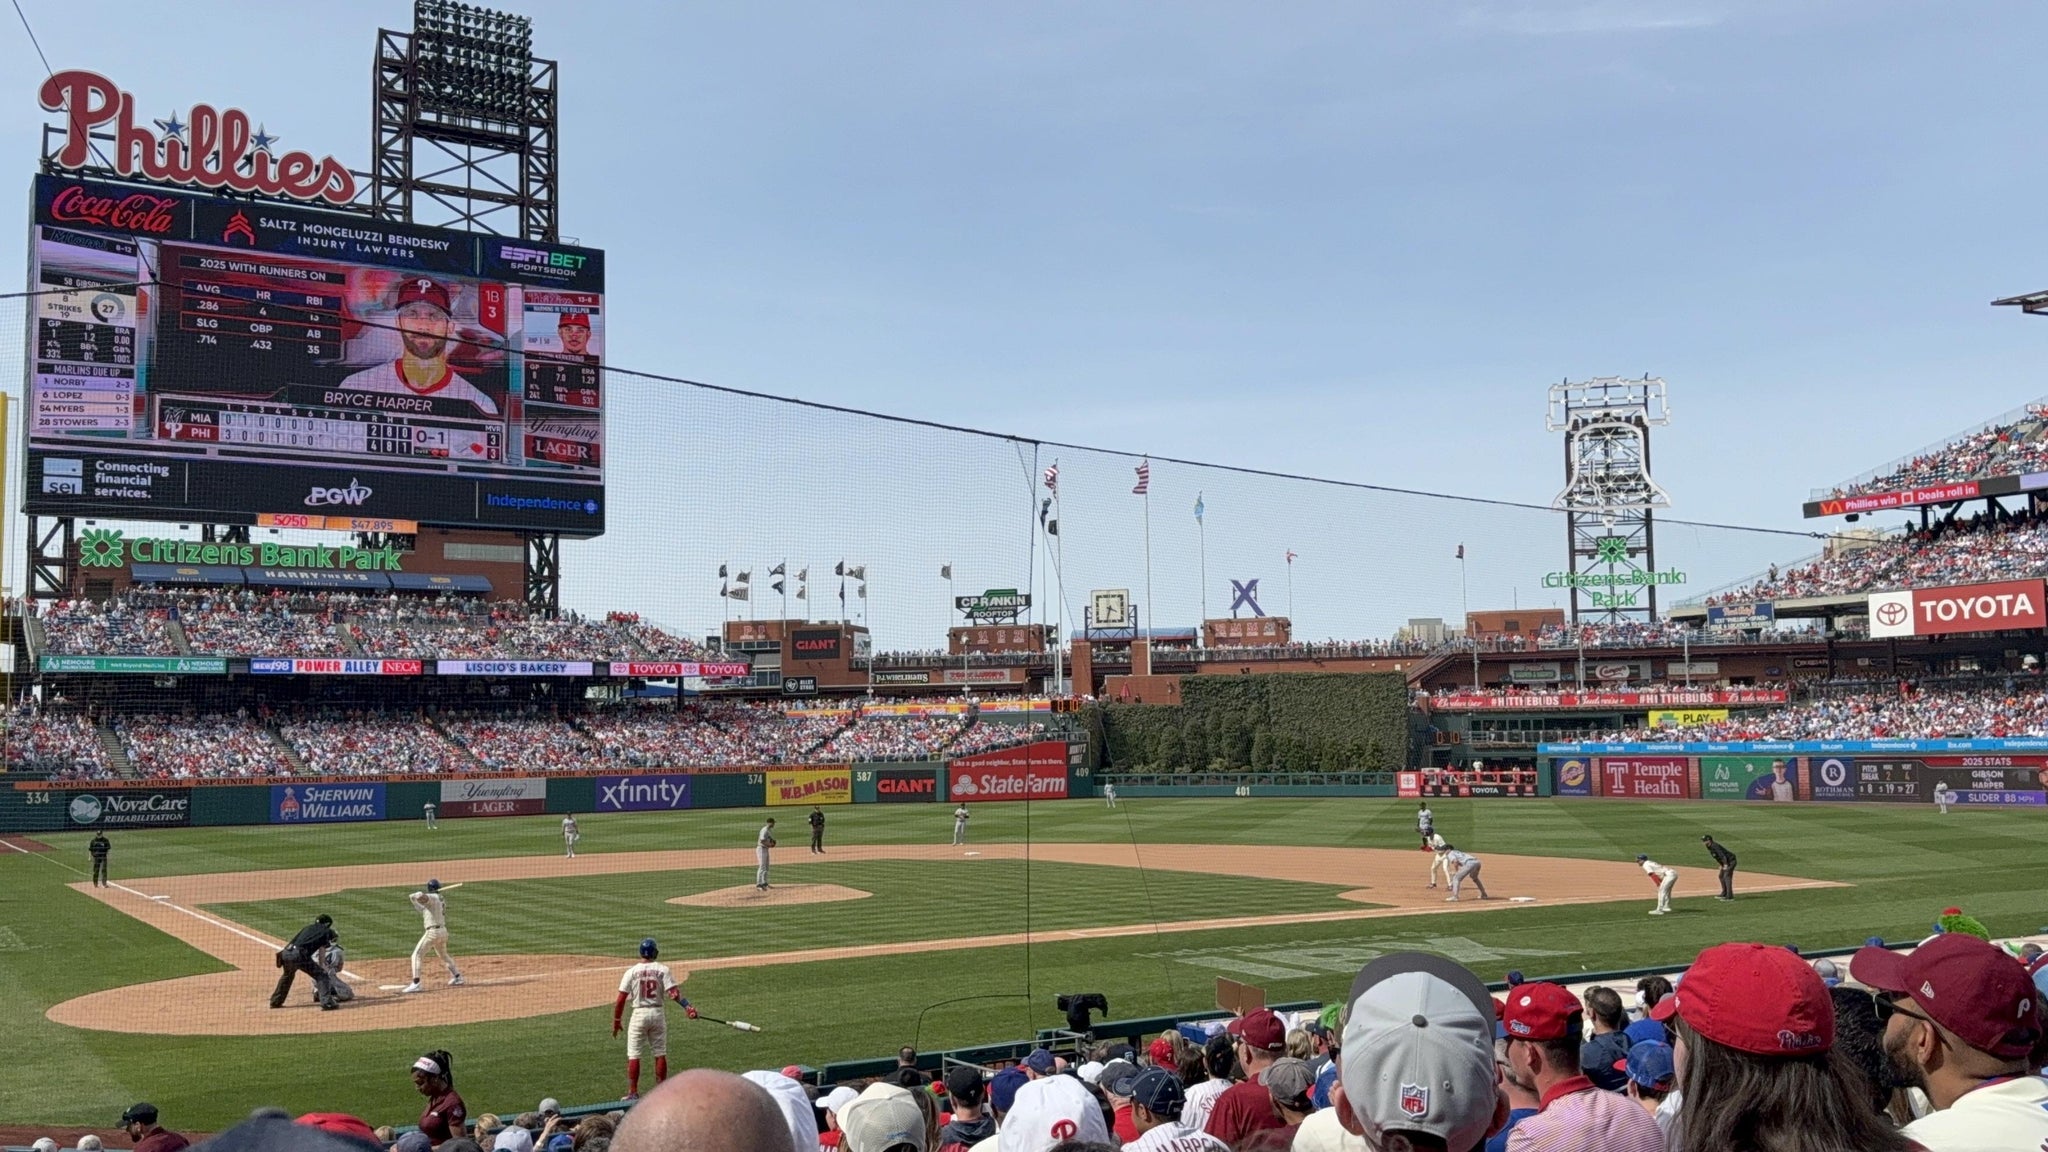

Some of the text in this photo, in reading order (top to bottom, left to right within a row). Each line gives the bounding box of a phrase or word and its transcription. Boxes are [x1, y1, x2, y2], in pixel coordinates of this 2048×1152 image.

[38, 69, 356, 205] Phillies
[260, 217, 450, 251] SALTZ MONGELUZZI BENDESKY
[297, 236, 415, 258] INJURY LAWYERS
[550, 252, 587, 269] BET
[200, 259, 327, 281] 2025 WITH RUNNERS ON
[510, 262, 577, 277] SPORTSBOOK
[196, 284, 323, 306] AVG HR RBI
[485, 290, 500, 303] 1B
[102, 304, 114, 314] 27
[196, 300, 219, 311] .286
[488, 306, 497, 318] 3
[196, 318, 321, 339] SLG OBP AB
[307, 345, 320, 354] 35
[54, 365, 120, 377] MARLINS DUE UP
[53, 378, 87, 386] NORBY
[53, 391, 83, 399] LOPEZ
[323, 391, 433, 412] BRYCE HARPER
[53, 405, 85, 413] MYERS
[38, 418, 51, 426] 28
[53, 418, 98, 426] STOWERS
[190, 412, 212, 423] MIA
[191, 428, 210, 438] PHI
[525, 417, 598, 442] Yuengling
[535, 440, 589, 459] LAGER
[95, 460, 170, 477] Connecting
[95, 472, 152, 486] financial
[94, 486, 152, 499] services.
[309, 486, 366, 505] PGW
[1845, 485, 1975, 510] Phillies win Deals roll in
[486, 493, 581, 511] Independence
[130, 537, 402, 571] Citizens Bank Park
[1545, 567, 1683, 587] Citizens Bank
[1592, 590, 1637, 607] Park
[973, 609, 1015, 619] ROOFTOP
[1919, 592, 2037, 623] TOYOTA
[795, 639, 837, 650] GIANT
[295, 660, 380, 672] POWER ALLEY
[465, 662, 567, 673] LISCIO'S BAKERY
[632, 663, 678, 674] TOYOTA
[703, 663, 746, 674] TOYOTA
[1962, 757, 2012, 766] 2025 STATS
[856, 770, 872, 781] 387
[1075, 767, 1090, 778] 409
[1632, 761, 1683, 781] Temple
[1971, 770, 2004, 778] GIBSON
[747, 774, 763, 785] 374
[877, 778, 935, 793] GIANT
[1971, 781, 2004, 790] HARPER
[460, 782, 528, 800] Yuengling
[602, 778, 686, 809] xfinity
[1234, 786, 1250, 797] 401
[1633, 779, 1681, 795] Health
[26, 791, 50, 804] 334
[303, 787, 374, 803] SHERWIN
[1968, 792, 2000, 803] SLIDER
[2004, 793, 2017, 803] 88
[105, 794, 188, 812] NovaCare
[472, 801, 515, 813] LAGER
[104, 812, 184, 824] REHABILITATION
[639, 979, 657, 999] 12
